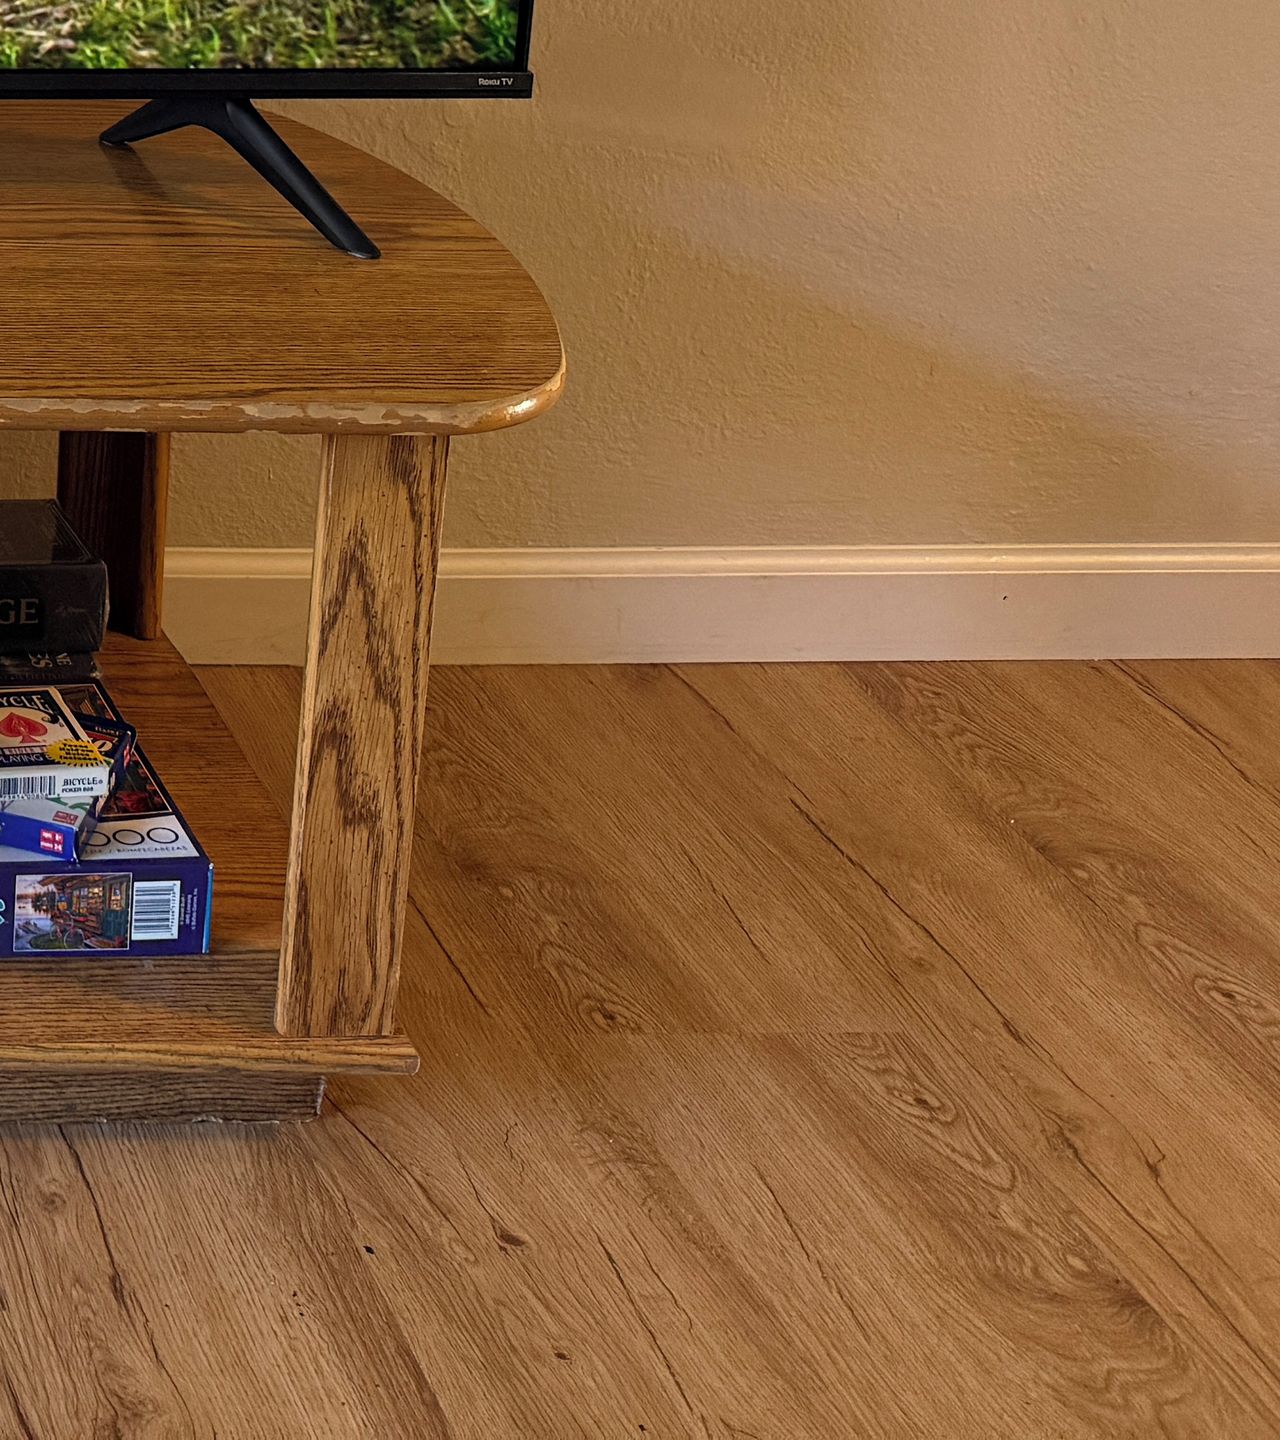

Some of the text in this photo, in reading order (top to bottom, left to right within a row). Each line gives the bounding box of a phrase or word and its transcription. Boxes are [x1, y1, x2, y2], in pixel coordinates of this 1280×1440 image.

[478, 78, 514, 86] Roku TV
[62, 777, 98, 786] BICYCLE
[82, 827, 179, 847] 000
